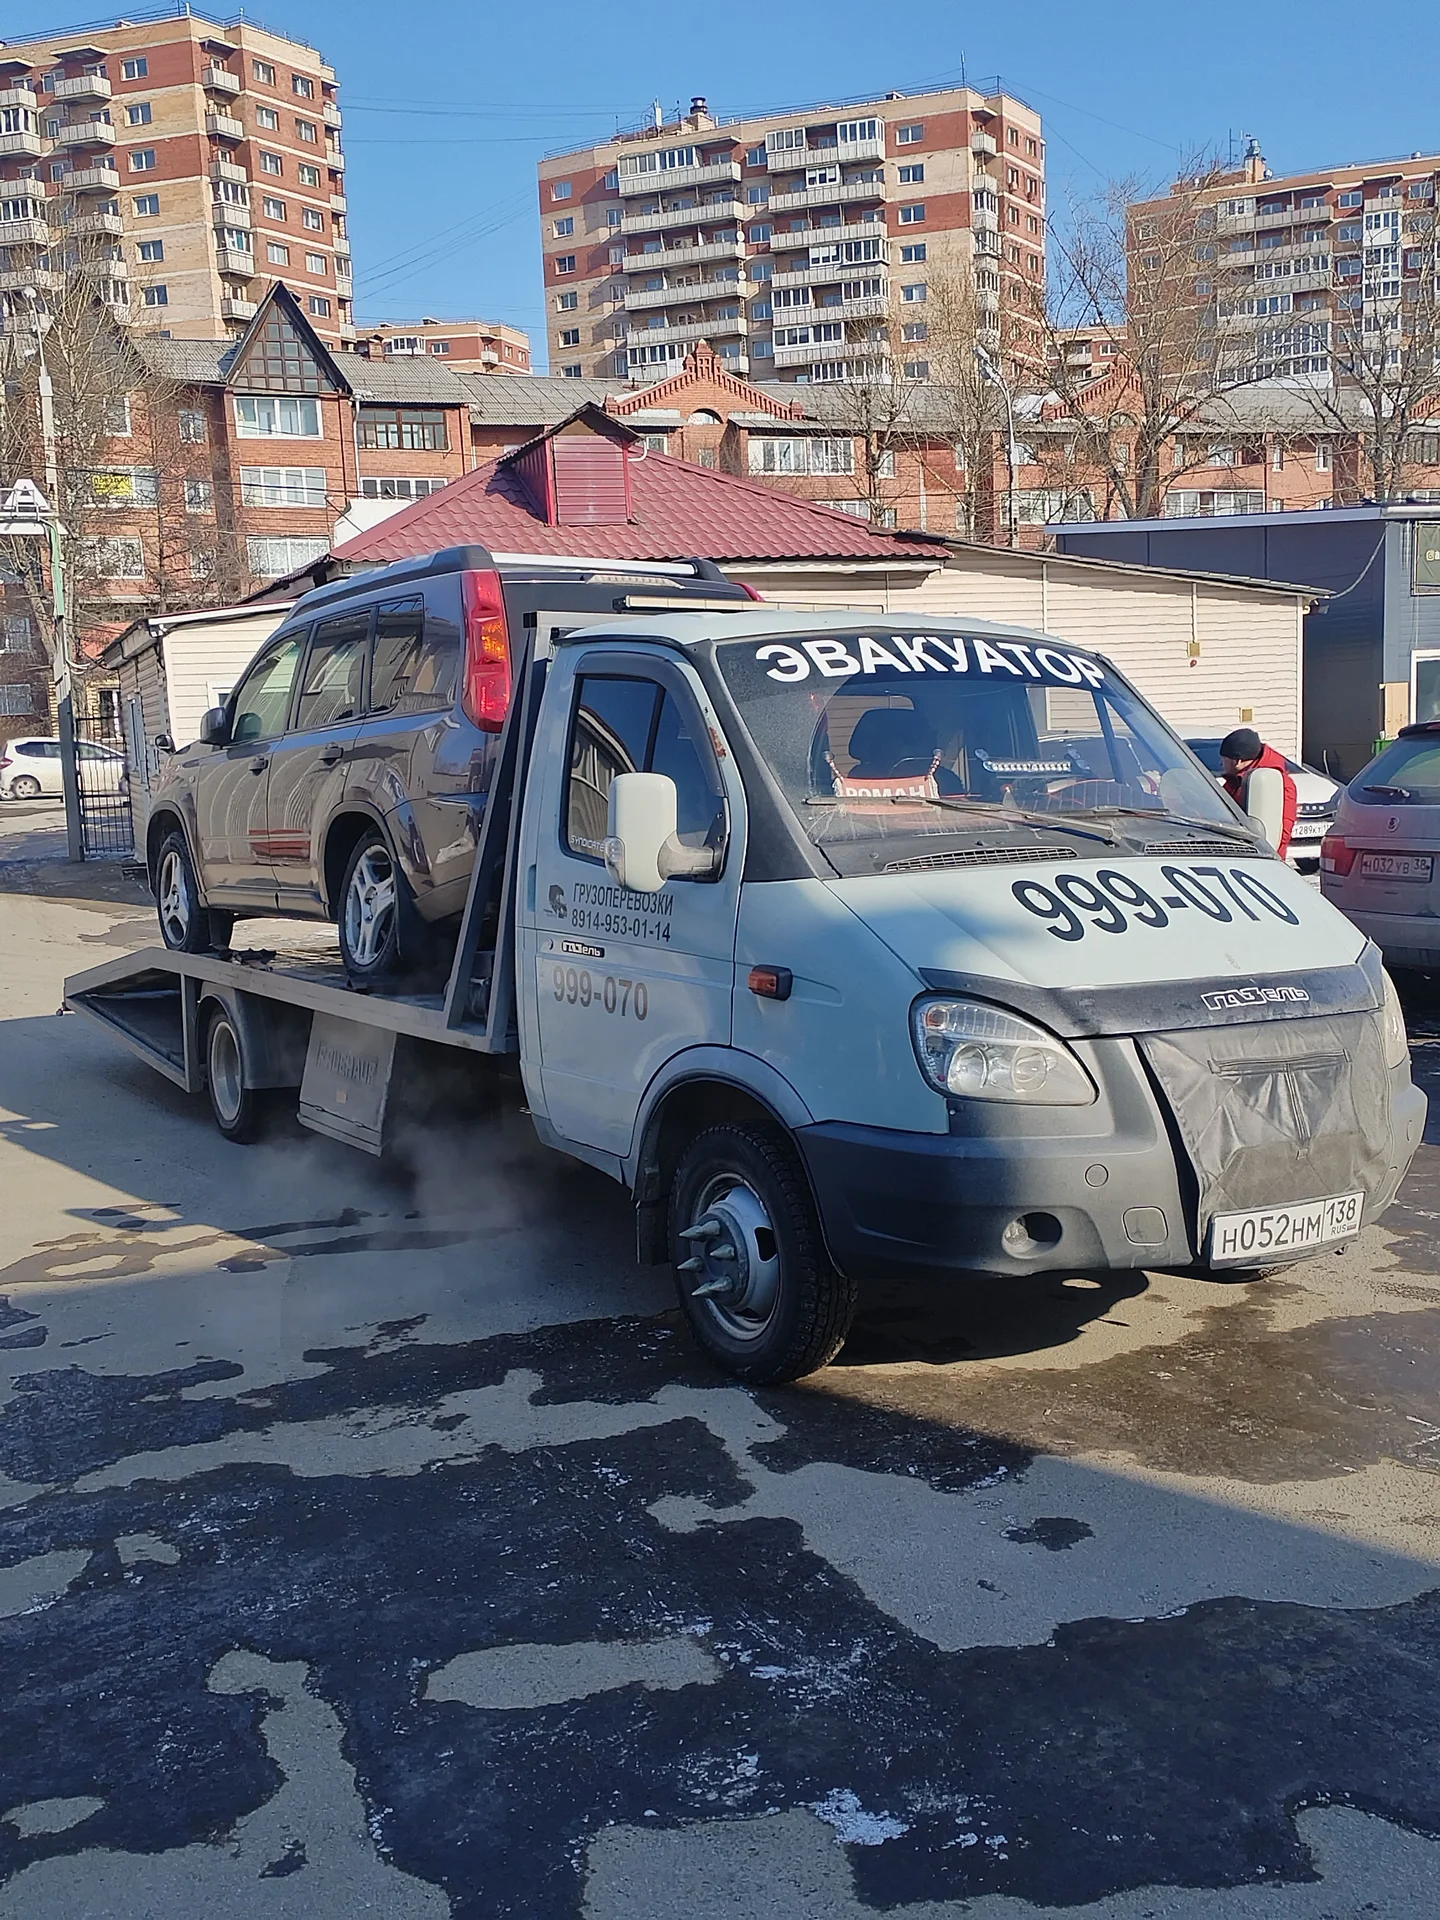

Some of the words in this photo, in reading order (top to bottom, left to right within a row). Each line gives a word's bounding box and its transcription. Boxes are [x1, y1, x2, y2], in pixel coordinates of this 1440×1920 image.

[756, 637, 1105, 689] ЭВАКУАТОР
[571, 908, 671, 942] 8914-953-01-14
[573, 883, 674, 916] ГРУЗОПЕРЕВОЗКИ
[1011, 865, 1300, 942] 999-070
[553, 965, 648, 1021] 999-070
[1222, 1213, 1322, 1254] Н052НМ
[1326, 1198, 1357, 1226] 138
[1331, 1223, 1347, 1236] RUS
